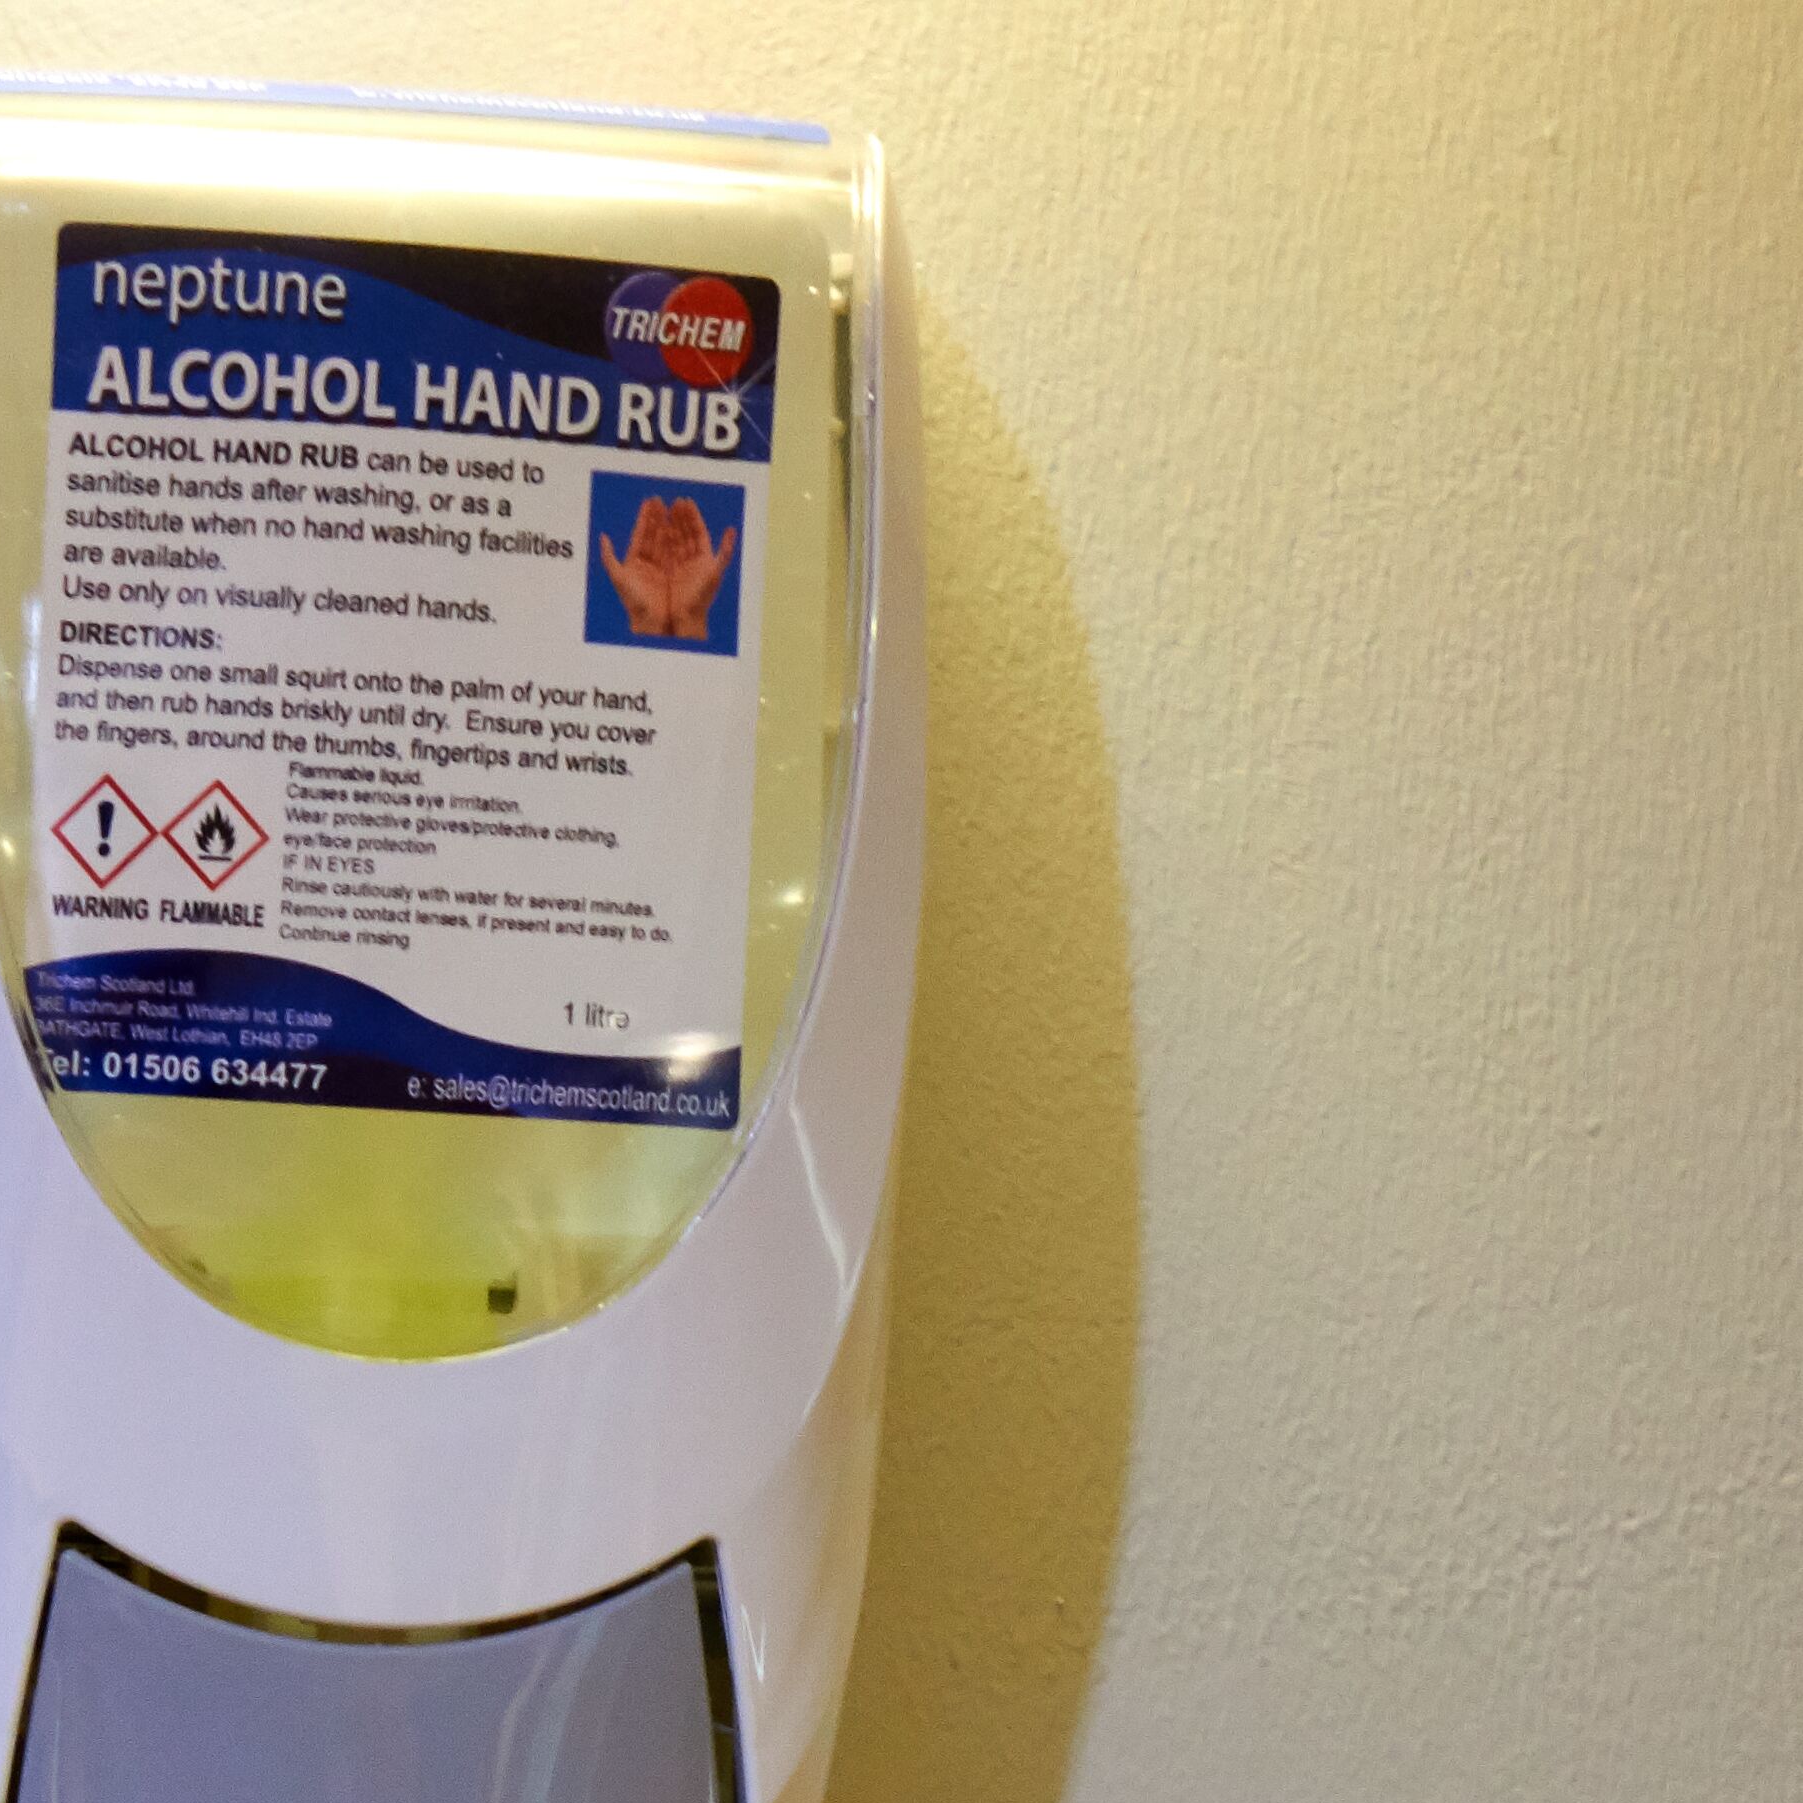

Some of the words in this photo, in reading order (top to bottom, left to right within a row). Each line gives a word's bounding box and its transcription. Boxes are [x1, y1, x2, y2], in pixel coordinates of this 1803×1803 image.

[92, 257, 347, 324] neptune
[610, 305, 748, 354] TRICHEM
[88, 346, 397, 422] ALCOHOL
[413, 362, 601, 436] HAND
[616, 381, 745, 452] RUB
[69, 432, 204, 462] ALCOHOL
[213, 439, 291, 465] HAND
[300, 443, 358, 469] RUB
[367, 451, 411, 473] can
[420, 451, 447, 475] be
[457, 459, 513, 481] used
[523, 460, 544, 483] to
[67, 470, 160, 496] sanitise
[169, 473, 243, 499] hands
[251, 478, 307, 502] after
[315, 484, 420, 514] washing,
[429, 493, 452, 512] or
[461, 497, 489, 514] as
[498, 499, 511, 517] a
[65, 505, 183, 533] substitute
[192, 512, 257, 536] when
[265, 519, 295, 538] no
[303, 516, 365, 541] hand
[371, 523, 471, 554] washing
[480, 527, 574, 559] facilities
[64, 544, 103, 564] are
[111, 546, 226, 570] available.
[63, 574, 110, 600] Use
[119, 579, 169, 609] only
[177, 586, 207, 605] on
[216, 583, 305, 614] visually
[314, 588, 408, 615] cleaned
[417, 594, 496, 622] hands.
[59, 619, 223, 651] DIRECTIONS:
[58, 653, 162, 681] Dispense
[170, 662, 211, 682] one
[219, 663, 278, 685] small
[285, 667, 347, 691] squirt
[354, 672, 402, 693] onto
[409, 673, 443, 696] the
[451, 676, 504, 702] palm
[511, 680, 534, 701] of
[539, 687, 586, 708] your
[593, 687, 652, 714] hand,
[56, 689, 97, 709] and
[106, 689, 153, 711] then
[161, 692, 197, 714] rub
[206, 694, 273, 718] hands
[281, 696, 352, 727] briskly
[359, 704, 405, 726] until
[412, 707, 450, 733] dry.
[466, 709, 543, 735] Ensure
[549, 719, 588, 742] you
[597, 726, 657, 746] cover
[55, 719, 89, 741] the
[97, 720, 178, 748] fingers,
[187, 729, 265, 750] around
[273, 730, 307, 752] the
[314, 732, 401, 761] thumbs,
[411, 737, 510, 769] fingertips
[518, 750, 557, 770] and
[566, 752, 633, 776] wrists.
[283, 854, 298, 869] IF
[304, 854, 322, 871] IN
[327, 856, 375, 874] EYES
[357, 837, 437, 854] protection
[52, 894, 149, 920] WARNING
[159, 899, 265, 927] FLAMMABLE
[454, 889, 497, 906] water
[504, 892, 523, 907] for
[280, 924, 350, 943] Continue
[357, 932, 410, 950] rinsing
[281, 900, 346, 919] Remove
[353, 907, 410, 923] contact
[555, 921, 585, 936] and
[589, 924, 625, 942] easy
[632, 924, 645, 940] to
[564, 1001, 573, 1026] 1
[46, 1049, 91, 1077] el:
[102, 1051, 201, 1083] 01506
[211, 1057, 327, 1091] 634477
[407, 1075, 426, 1098] e:
[433, 1073, 730, 1118] sales@trichemscotland.co.uk
